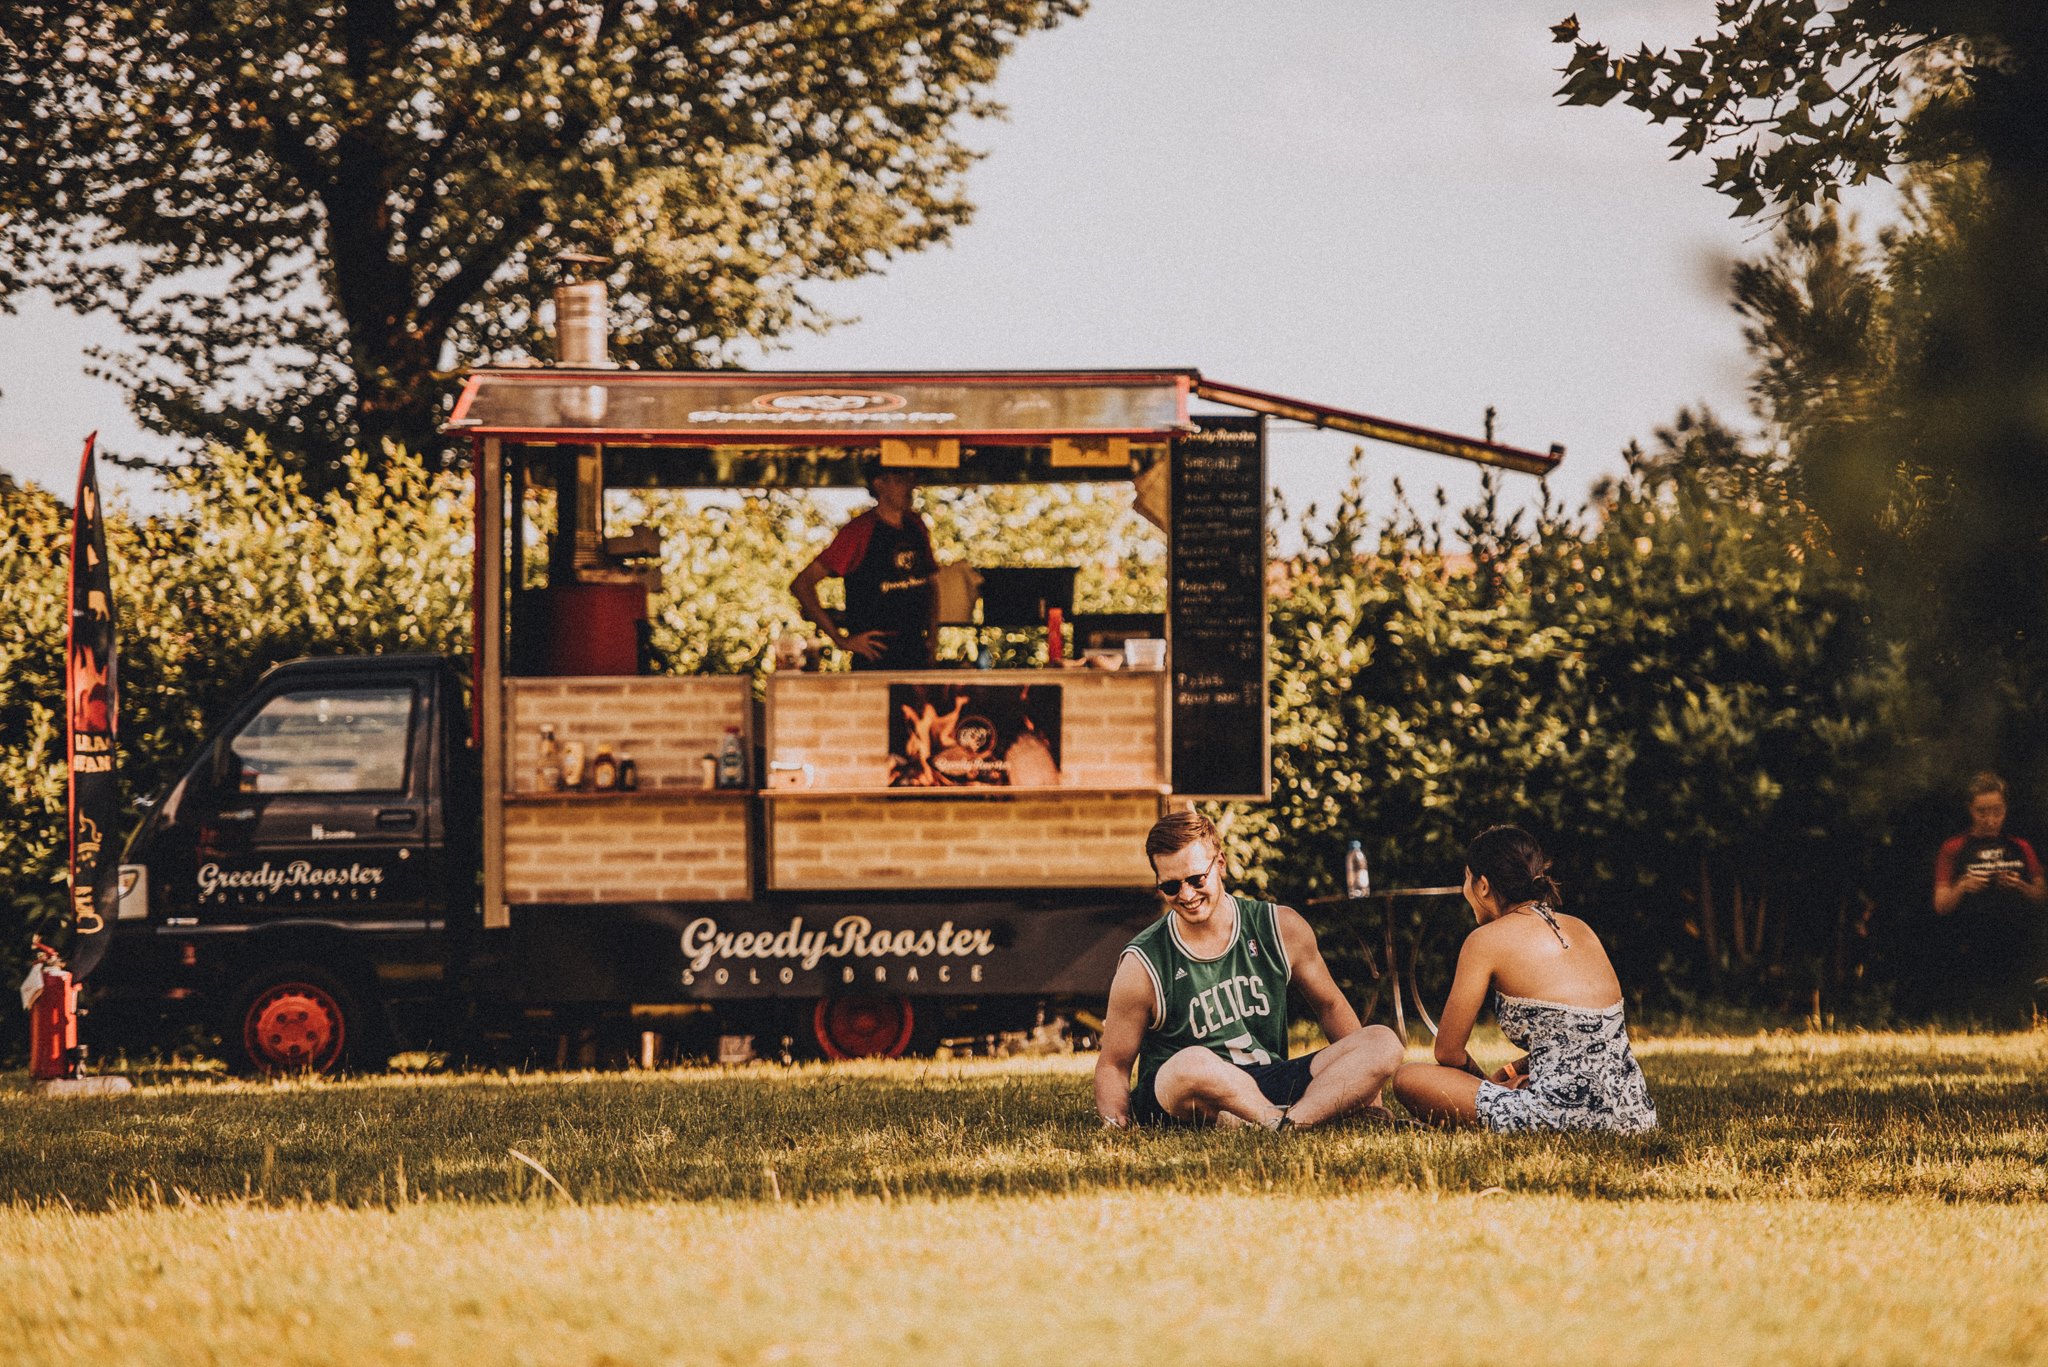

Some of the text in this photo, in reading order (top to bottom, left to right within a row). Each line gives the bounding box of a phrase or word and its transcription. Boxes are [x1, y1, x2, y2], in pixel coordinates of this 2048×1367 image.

[681, 964, 984, 985] SOLO BRACE
[1189, 975, 1271, 1039] CELTICS
